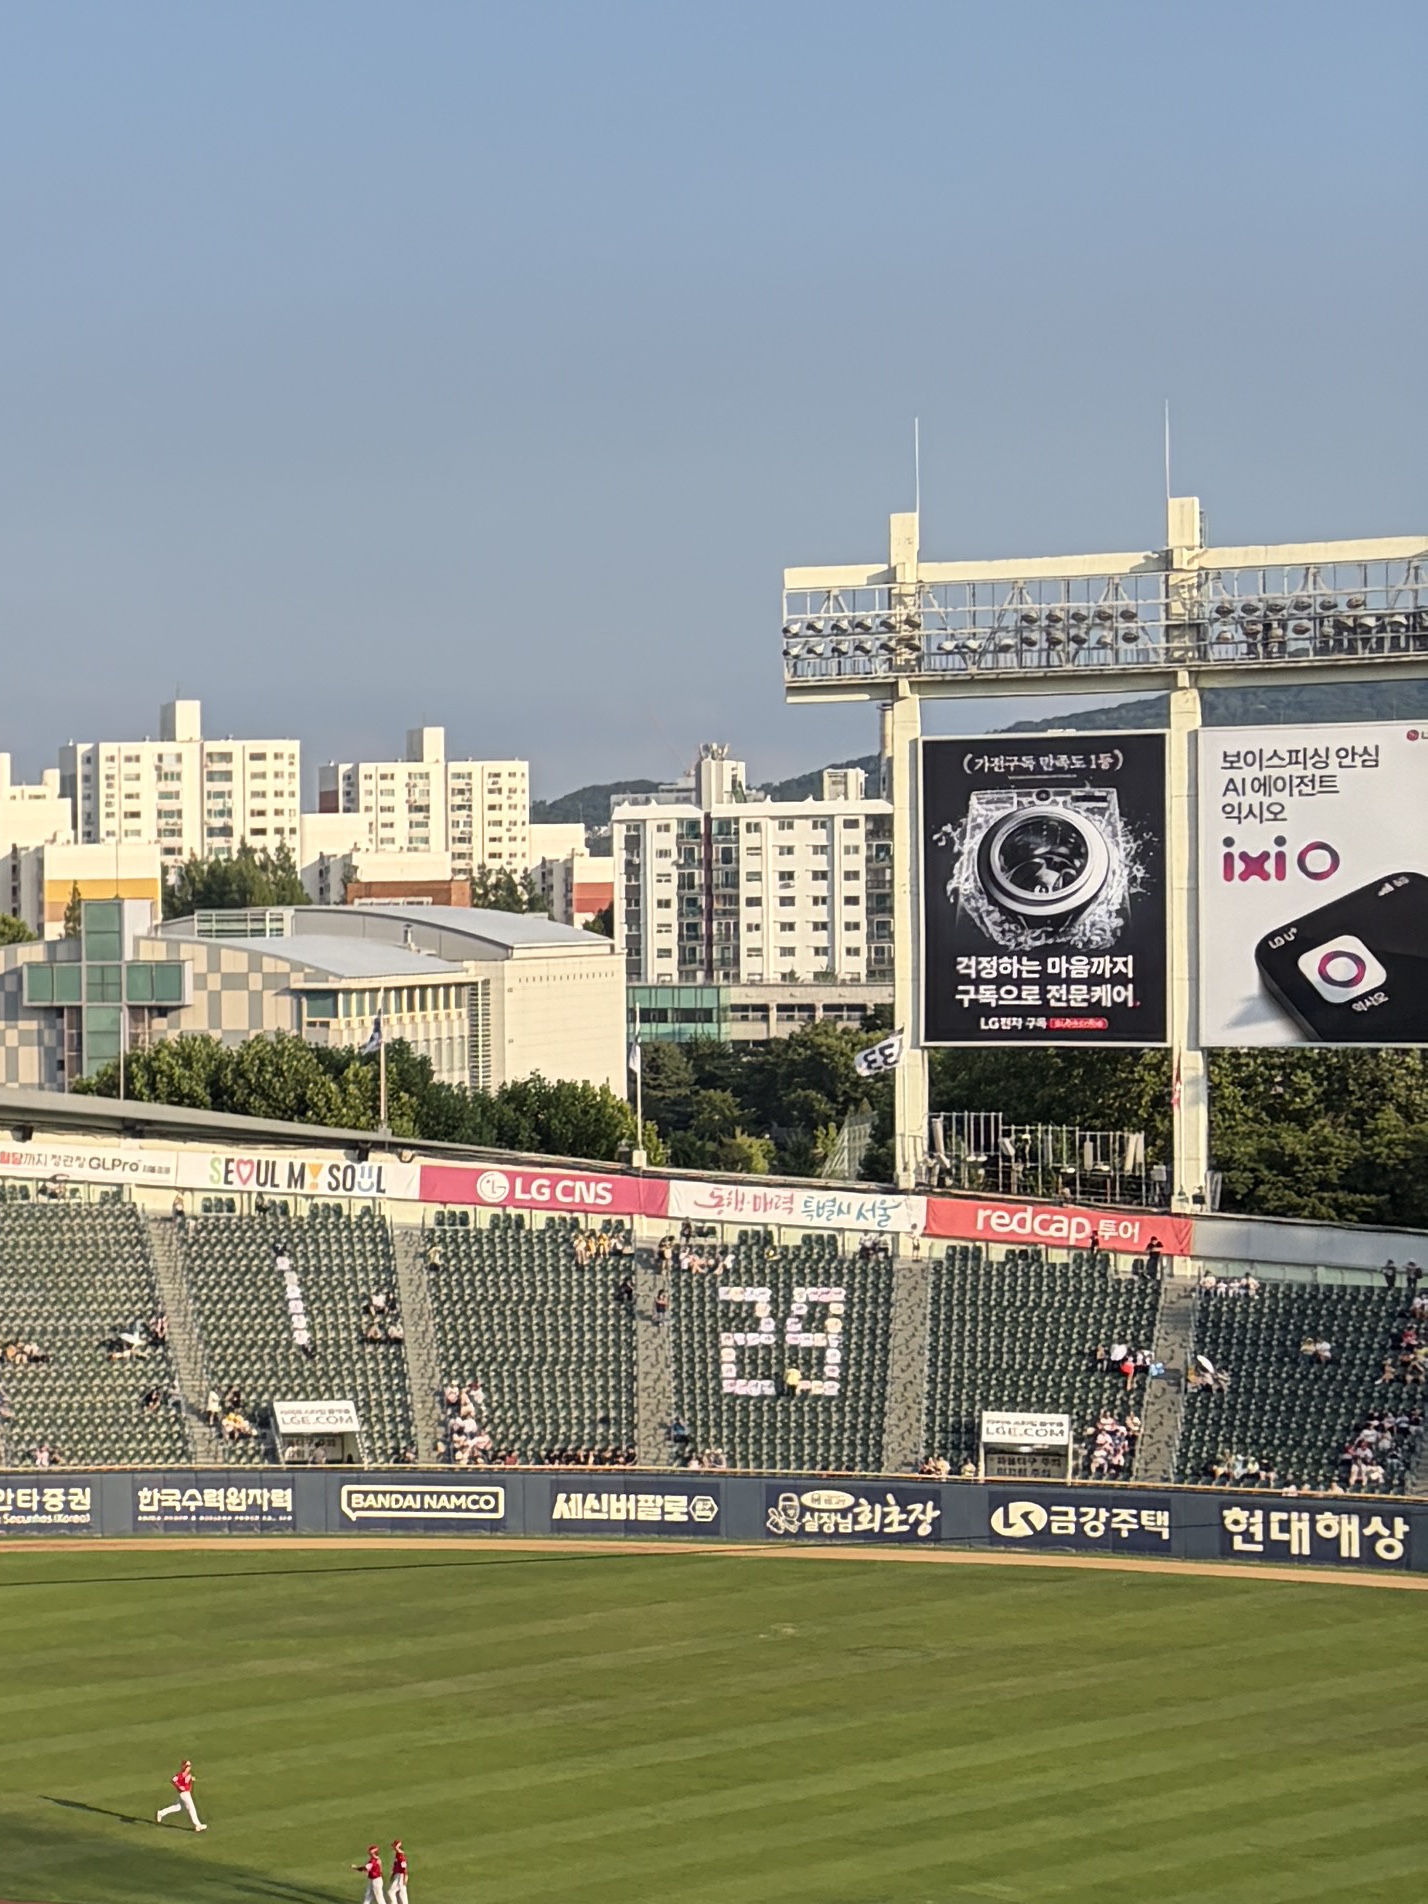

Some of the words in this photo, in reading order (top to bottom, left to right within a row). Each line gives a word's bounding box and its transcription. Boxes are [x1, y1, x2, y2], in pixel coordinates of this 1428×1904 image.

[1221, 747, 1331, 771] 보이스피싱
[1335, 744, 1381, 769] 안심
[1222, 776, 1246, 797] AI
[1250, 774, 1340, 797] 에이전트
[1221, 801, 1288, 824] 익시오
[955, 955, 1042, 979] 걱정하는
[1046, 954, 1134, 978] 마음까지
[955, 984, 1043, 1008] 구독으로
[515, 1177, 551, 1201] LG
[555, 1179, 613, 1206] CNS
[801, 1196, 852, 1222] 특별시
[855, 1200, 903, 1228] 서울
[976, 1206, 1093, 1245] redcap
[1098, 1219, 1140, 1244] 투어
[281, 1416, 354, 1426] LGE.COM
[137, 1487, 293, 1512] 한국수력원자력
[351, 1493, 421, 1509] BANDAI
[423, 1494, 496, 1510] NAMCO
[552, 1493, 689, 1522] 세신버팔로
[802, 1511, 853, 1534] 실장님
[1049, 1505, 1170, 1540] 금강주택
[1222, 1507, 1410, 1561] 현대해상
